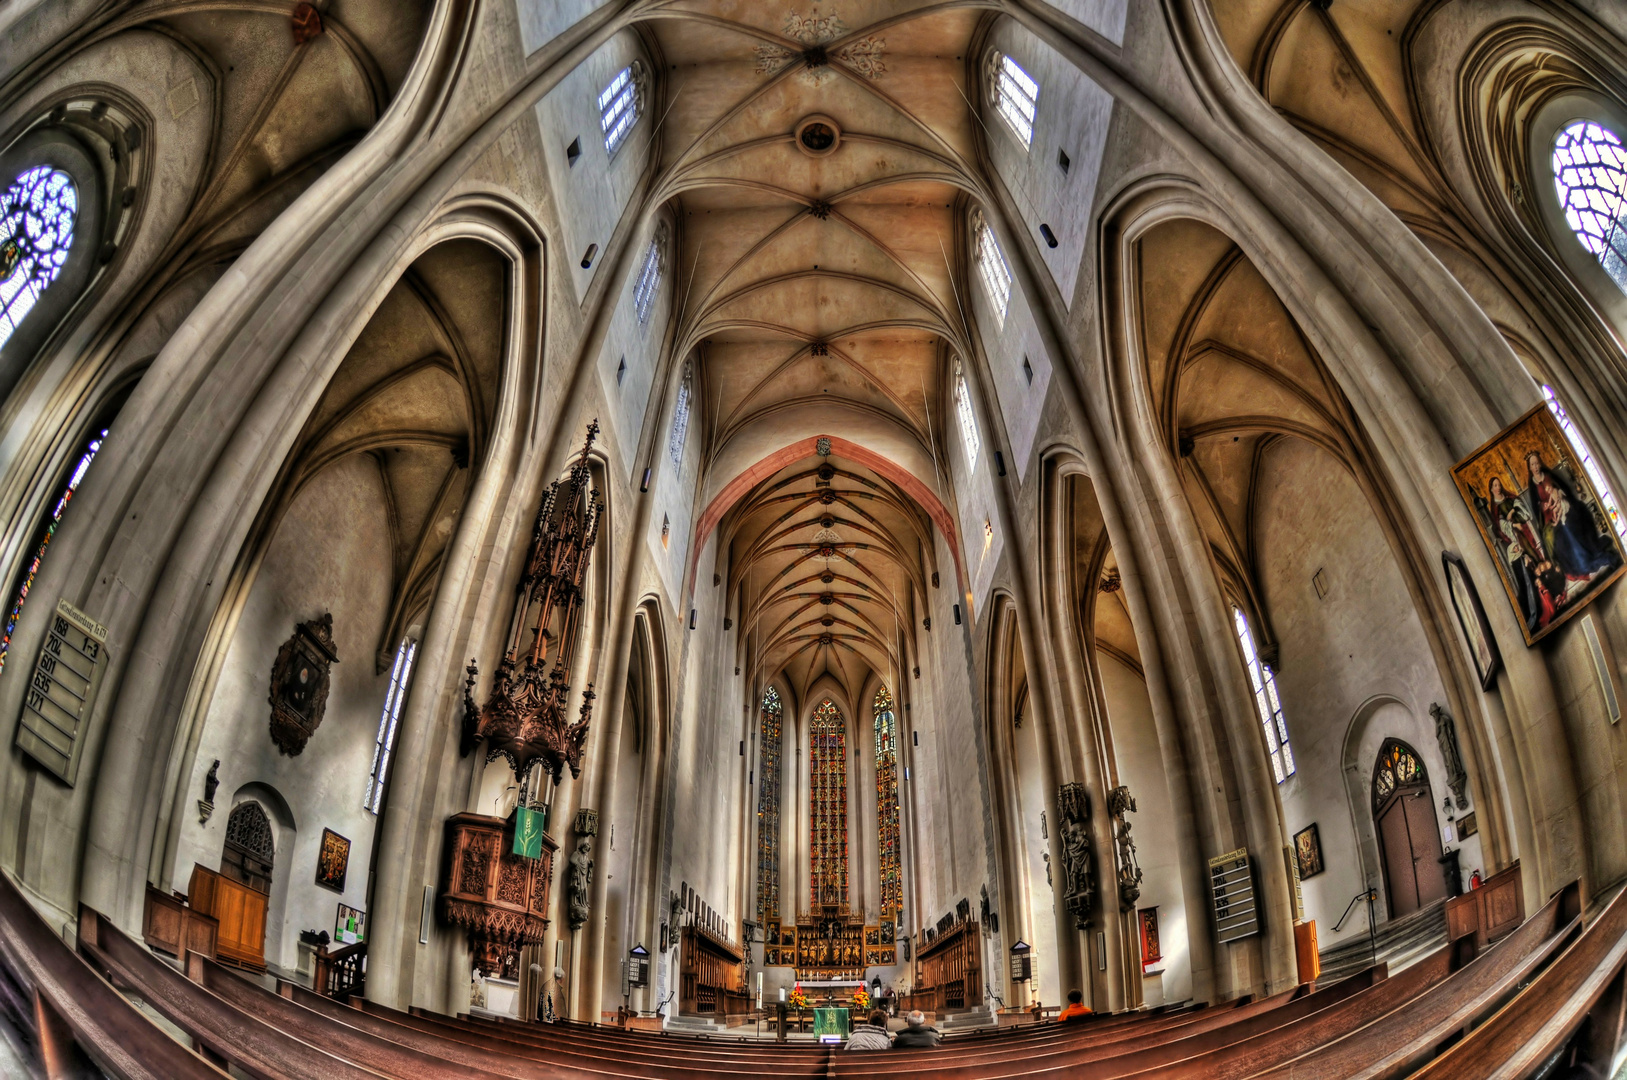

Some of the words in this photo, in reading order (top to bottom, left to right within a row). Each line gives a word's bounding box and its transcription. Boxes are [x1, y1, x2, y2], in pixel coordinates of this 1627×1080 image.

[53, 615, 68, 637] 168
[46, 635, 62, 657] 704
[40, 654, 56, 674] 601
[34, 672, 51, 694] 635
[29, 690, 44, 711] 171
